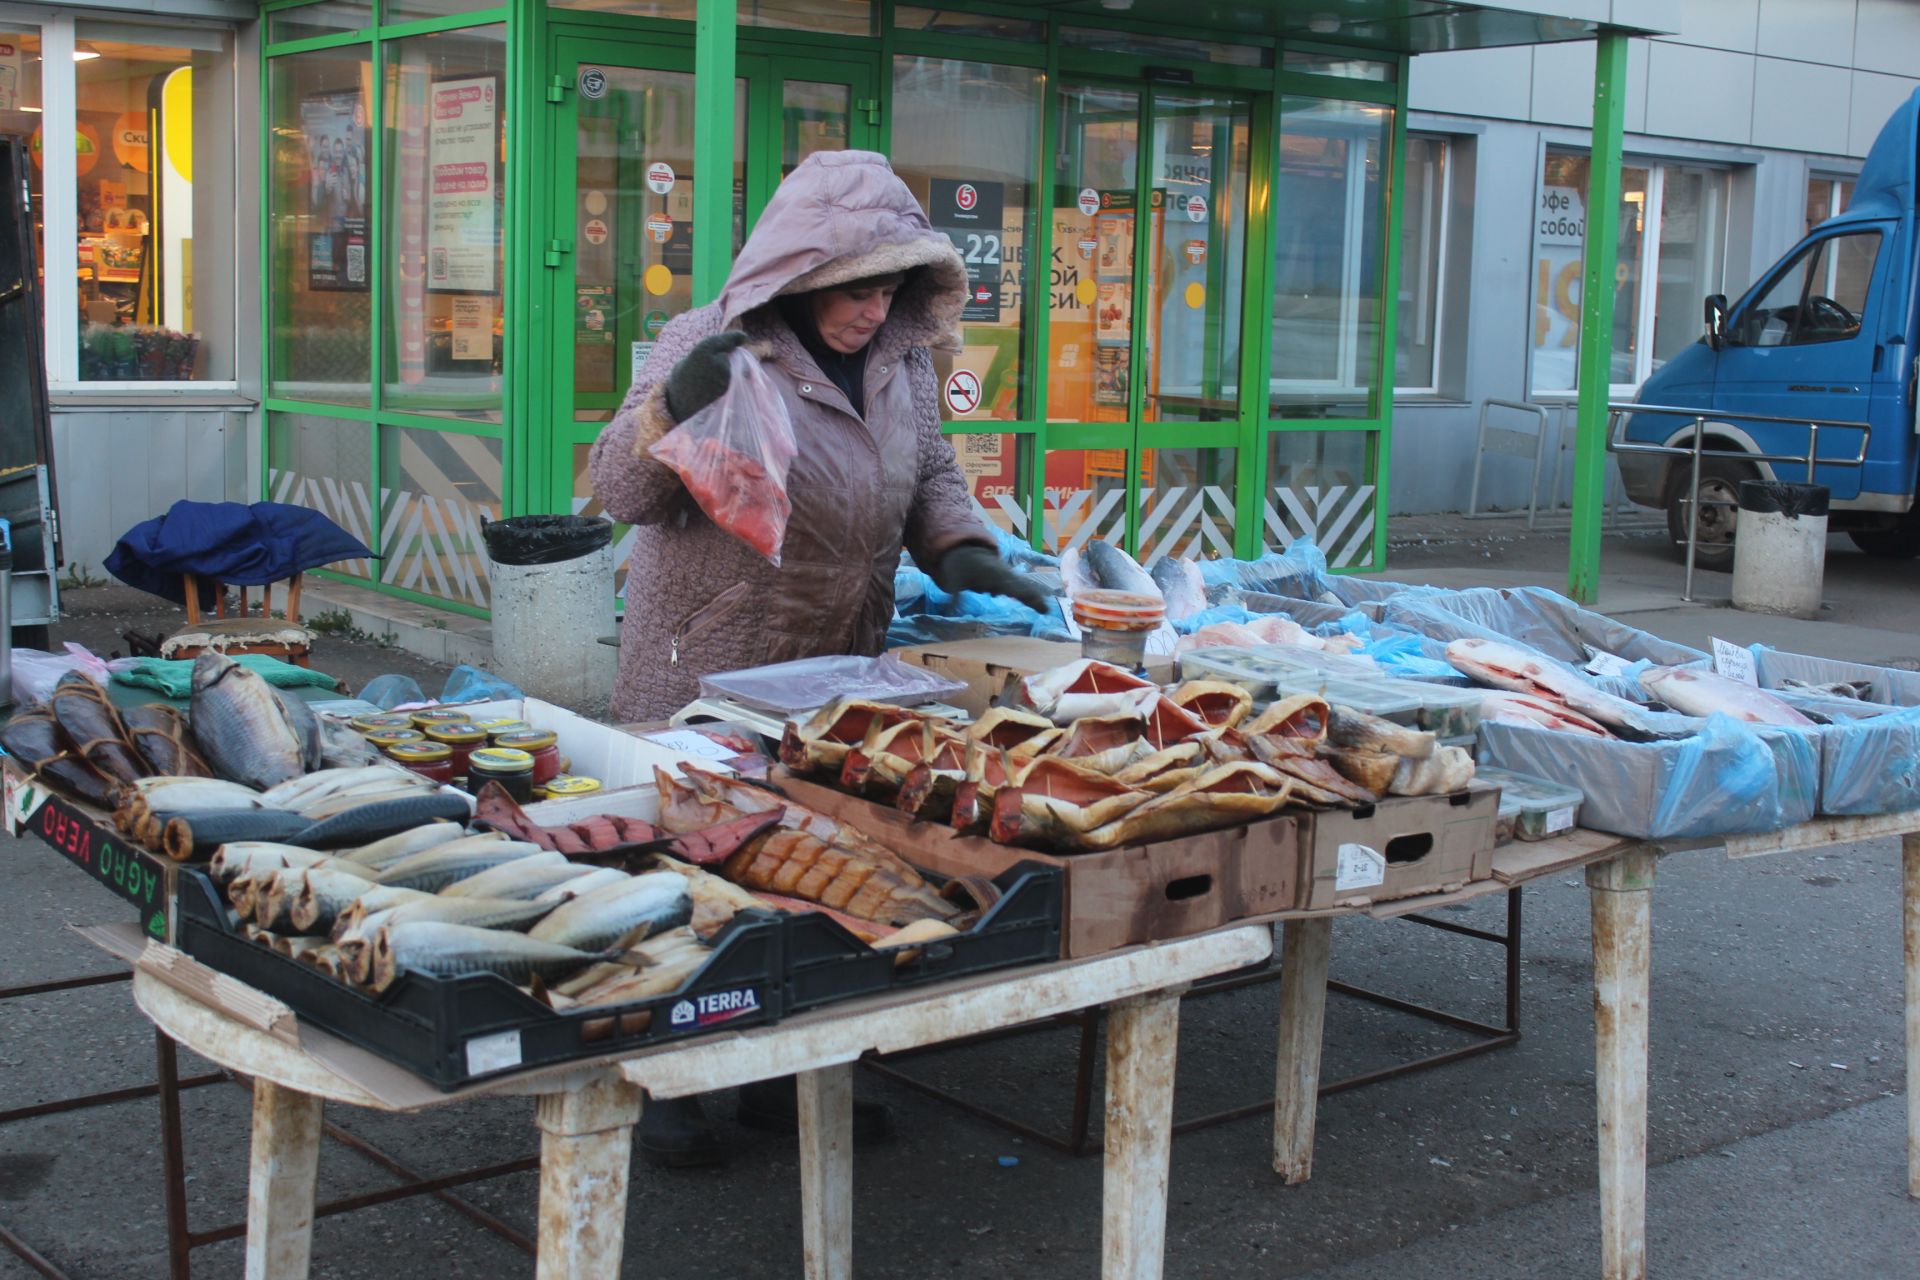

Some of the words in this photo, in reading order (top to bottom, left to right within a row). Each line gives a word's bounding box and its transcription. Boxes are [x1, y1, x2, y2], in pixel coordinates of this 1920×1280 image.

[43, 805, 91, 863] VERO
[100, 843, 156, 903] AGRO
[698, 989, 756, 1014] TERRA
